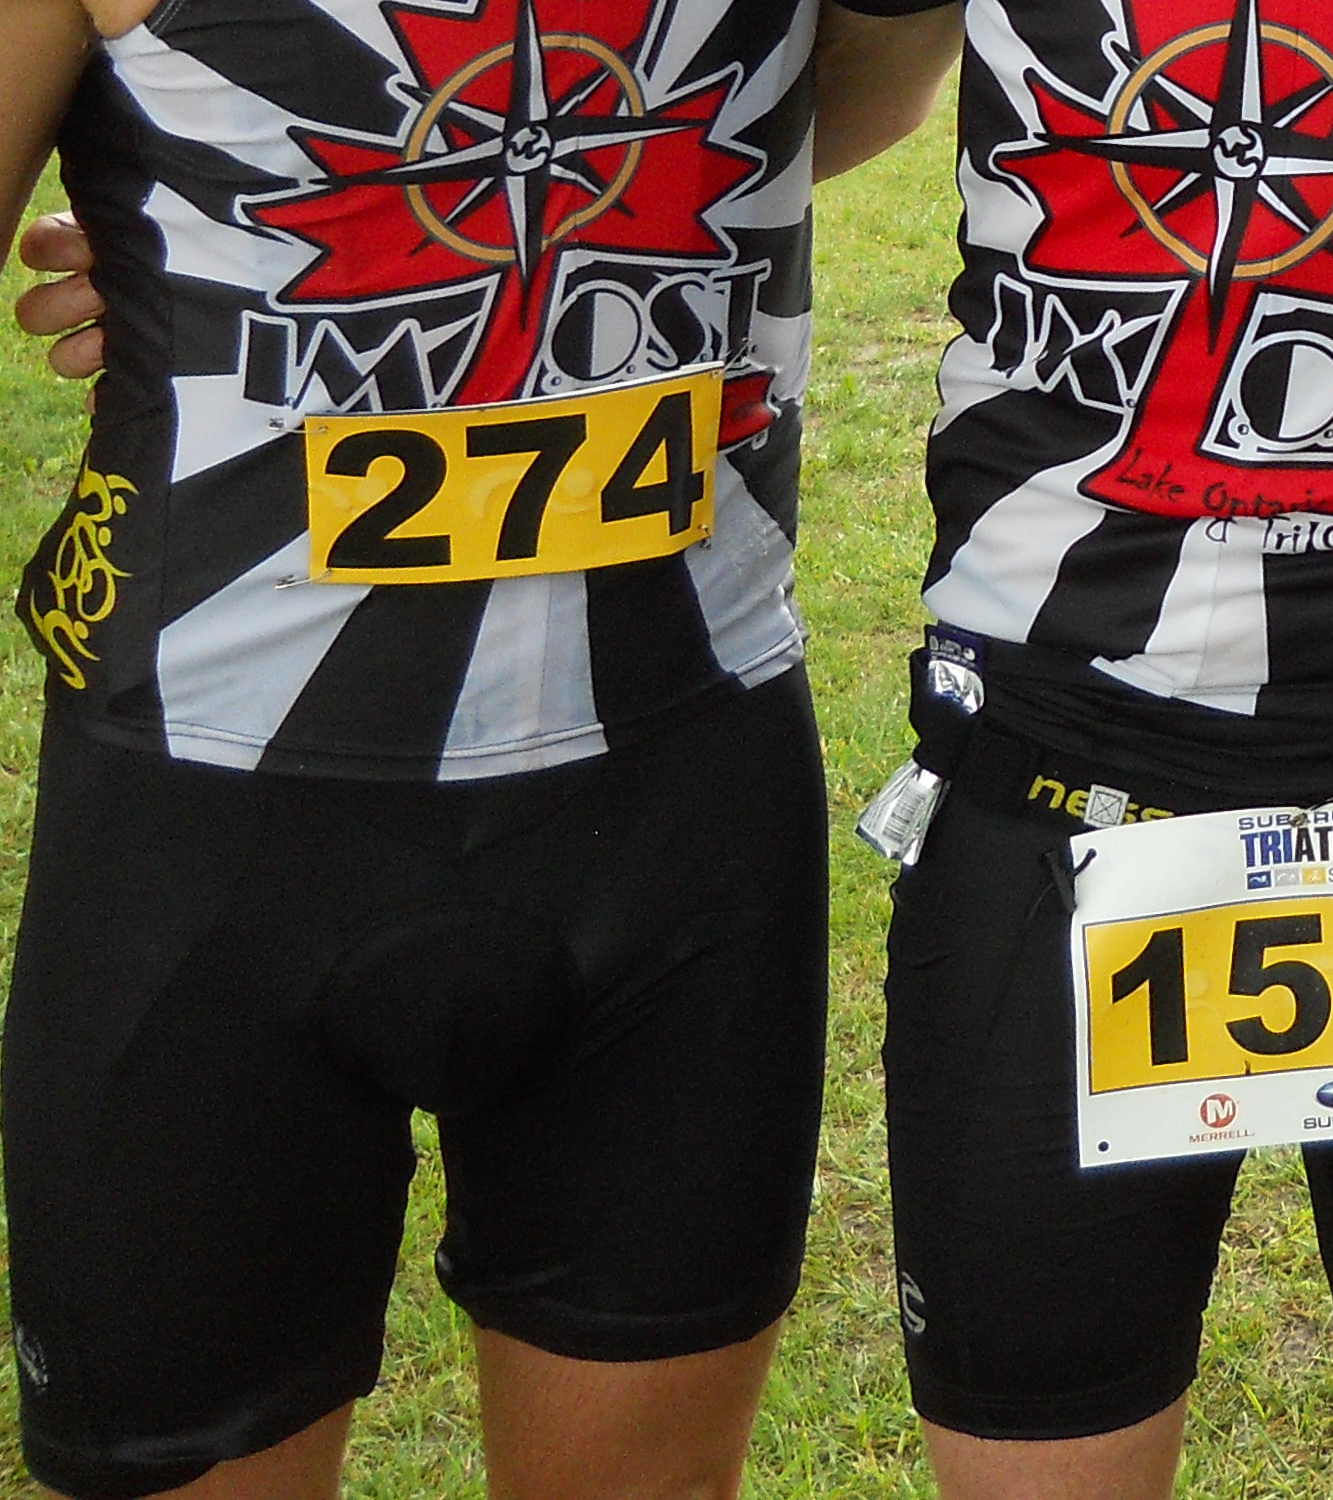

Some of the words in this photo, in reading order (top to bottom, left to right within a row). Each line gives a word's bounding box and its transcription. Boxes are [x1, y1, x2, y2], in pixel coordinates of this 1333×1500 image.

[325, 392, 705, 569] 274
[1116, 447, 1185, 502] Lake
[1189, 1129, 1253, 1144] MERRELL
